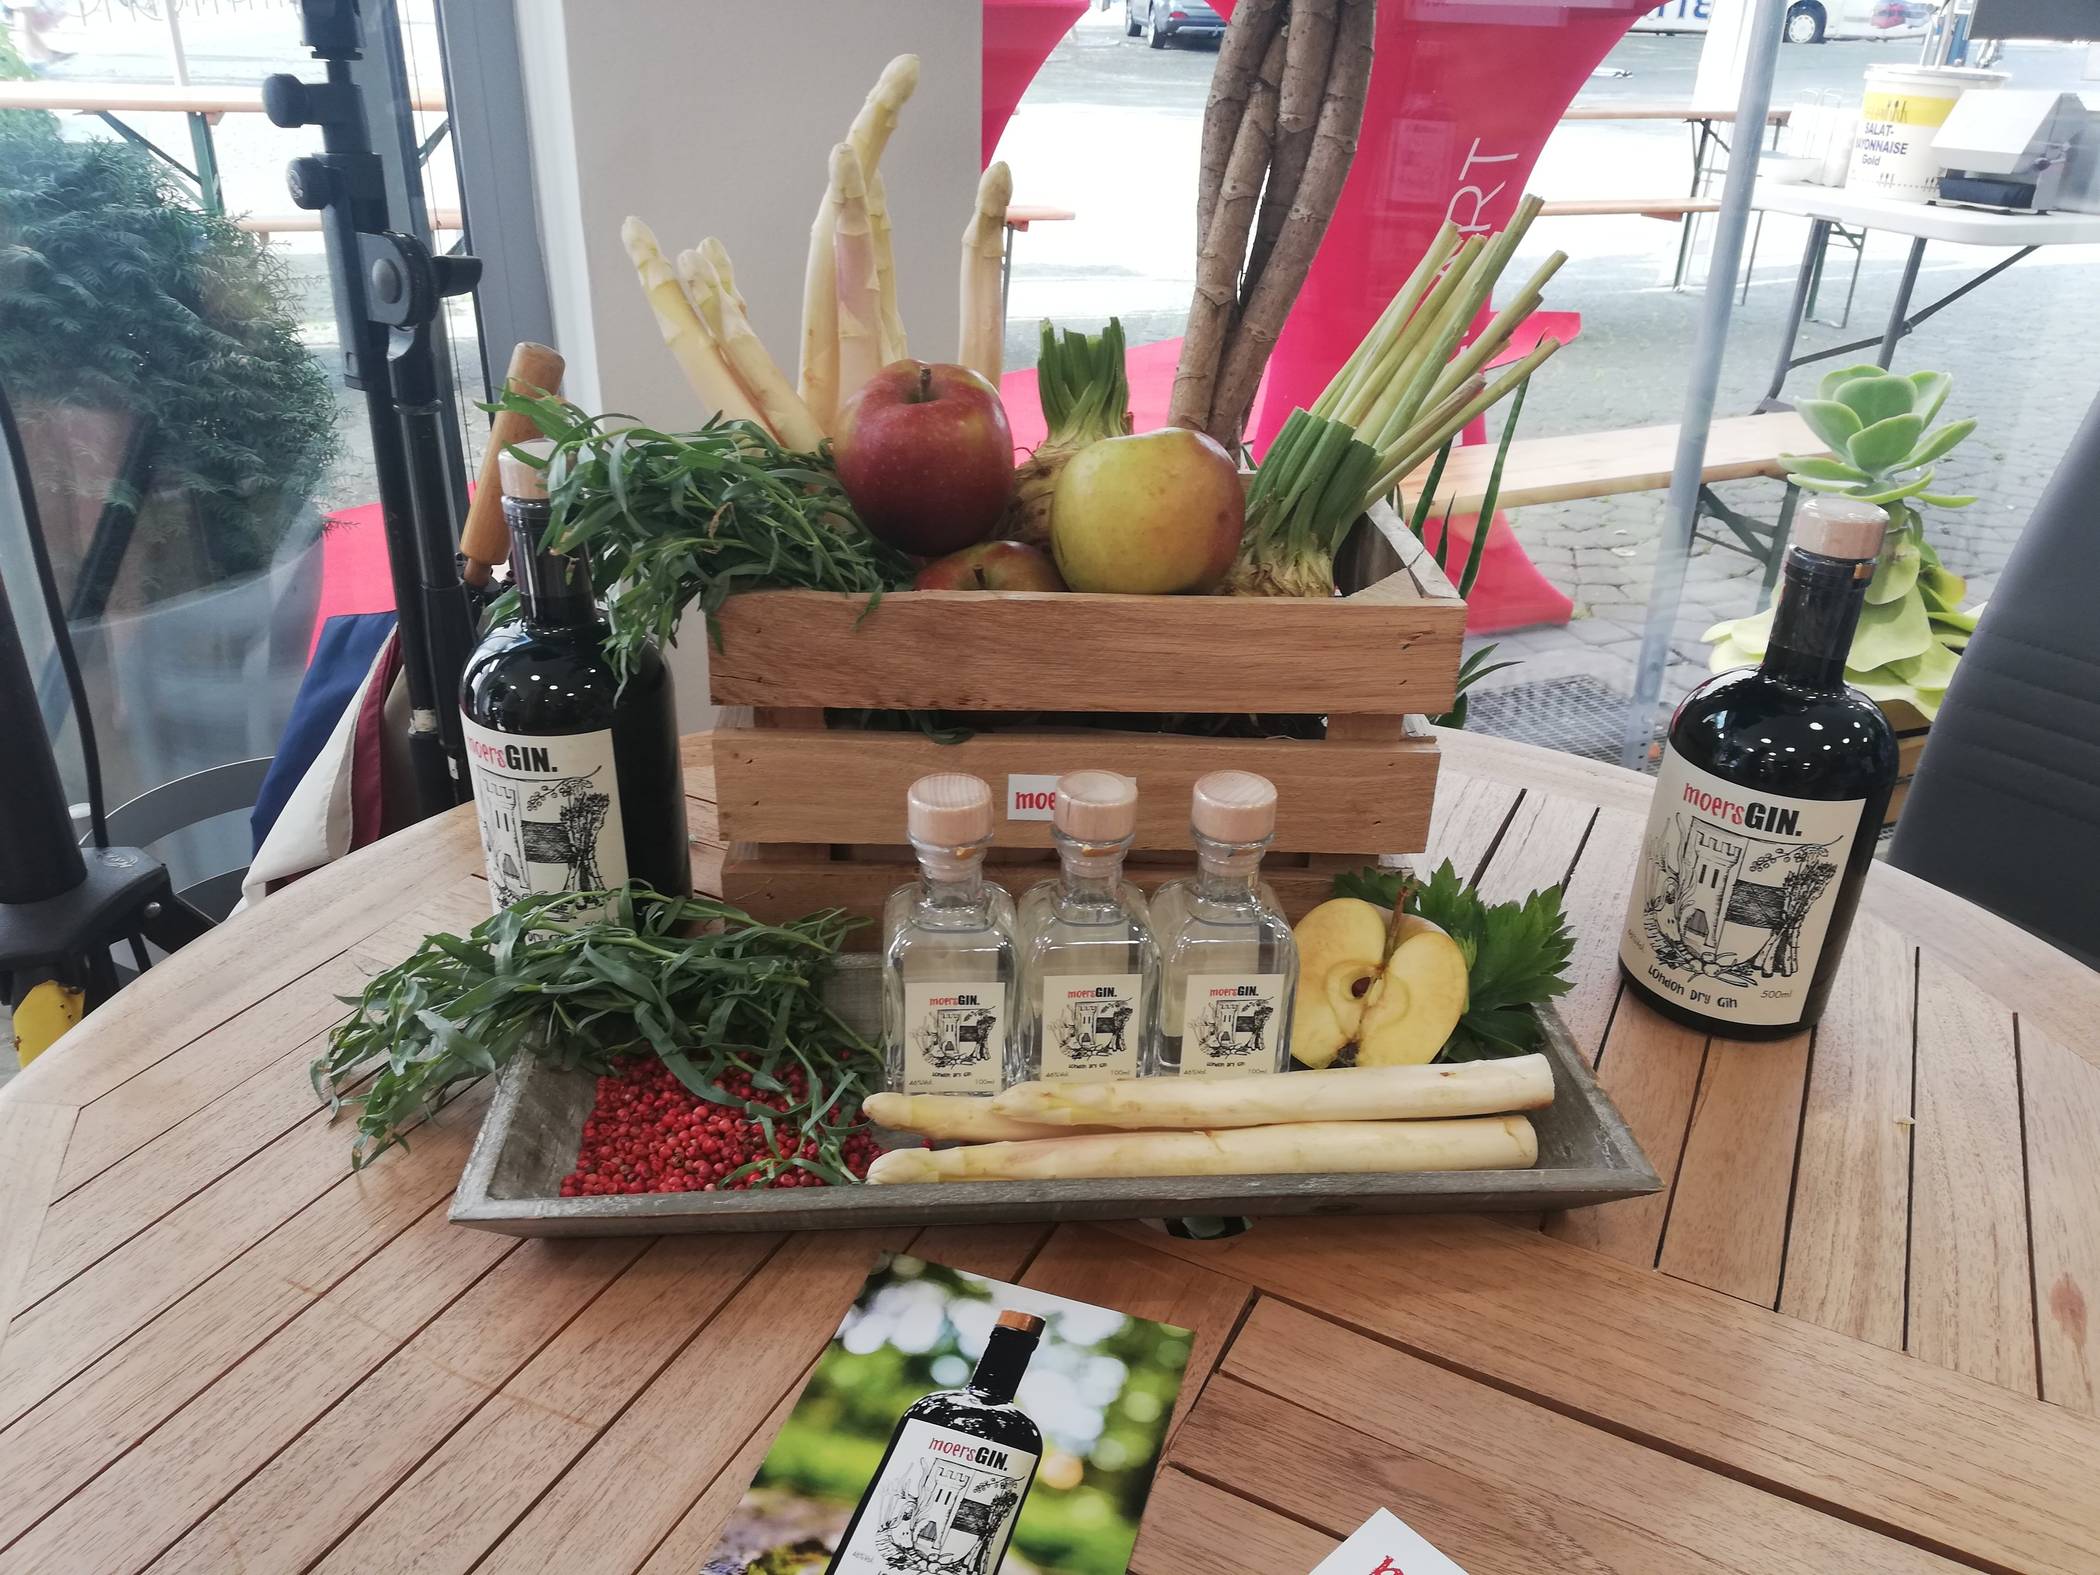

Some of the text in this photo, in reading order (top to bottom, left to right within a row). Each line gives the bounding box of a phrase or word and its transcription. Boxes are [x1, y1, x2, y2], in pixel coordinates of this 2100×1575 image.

[1856, 137, 1909, 155] AYONNAISE
[1683, 782, 1802, 836] moersGIN.
[1760, 989, 1793, 999] 500ml
[928, 1437, 1008, 1472] moersGIN.
